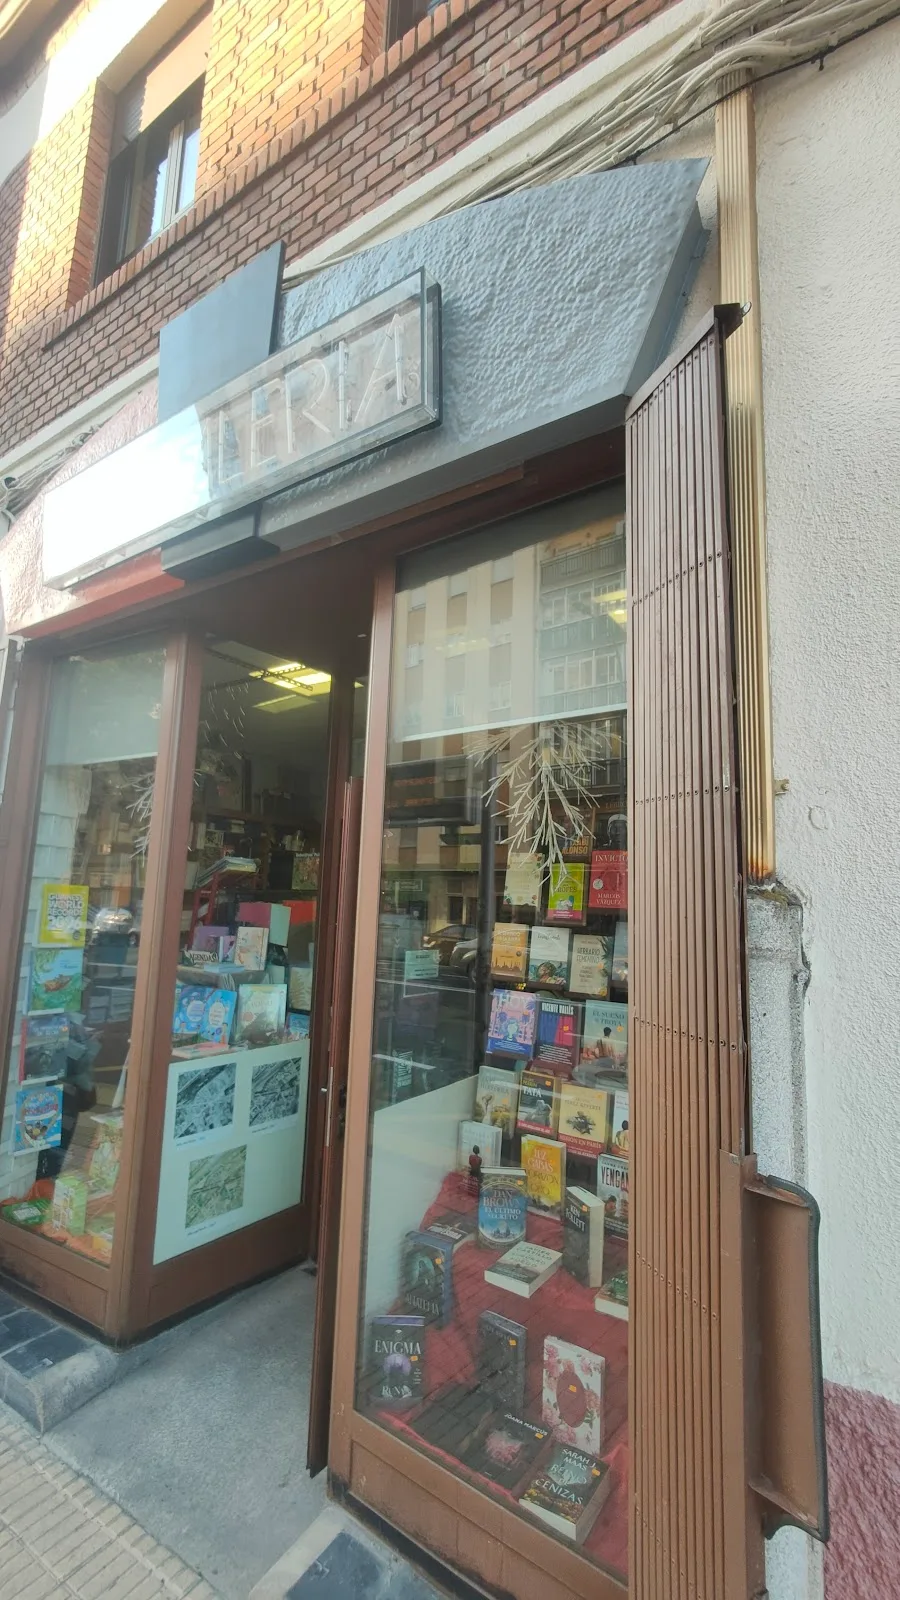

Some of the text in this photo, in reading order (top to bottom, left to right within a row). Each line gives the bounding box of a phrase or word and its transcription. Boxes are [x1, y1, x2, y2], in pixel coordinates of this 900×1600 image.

[48, 900, 84, 909] WORLD
[47, 908, 83, 917] RECORDS
[541, 1002, 559, 1013] VICENTE
[494, 1190, 513, 1198] DAN
[483, 1196, 521, 1208] BROWN
[570, 1205, 580, 1218] KEN
[565, 1207, 586, 1232] FOLLETT
[375, 1340, 421, 1355] ENIGMA
[504, 1413, 523, 1425] JOANA
[562, 1449, 590, 1464] SARAH
[563, 1456, 588, 1471] MAAS
[550, 1463, 587, 1484] REINO
[535, 1478, 584, 1505] CENIZAS
